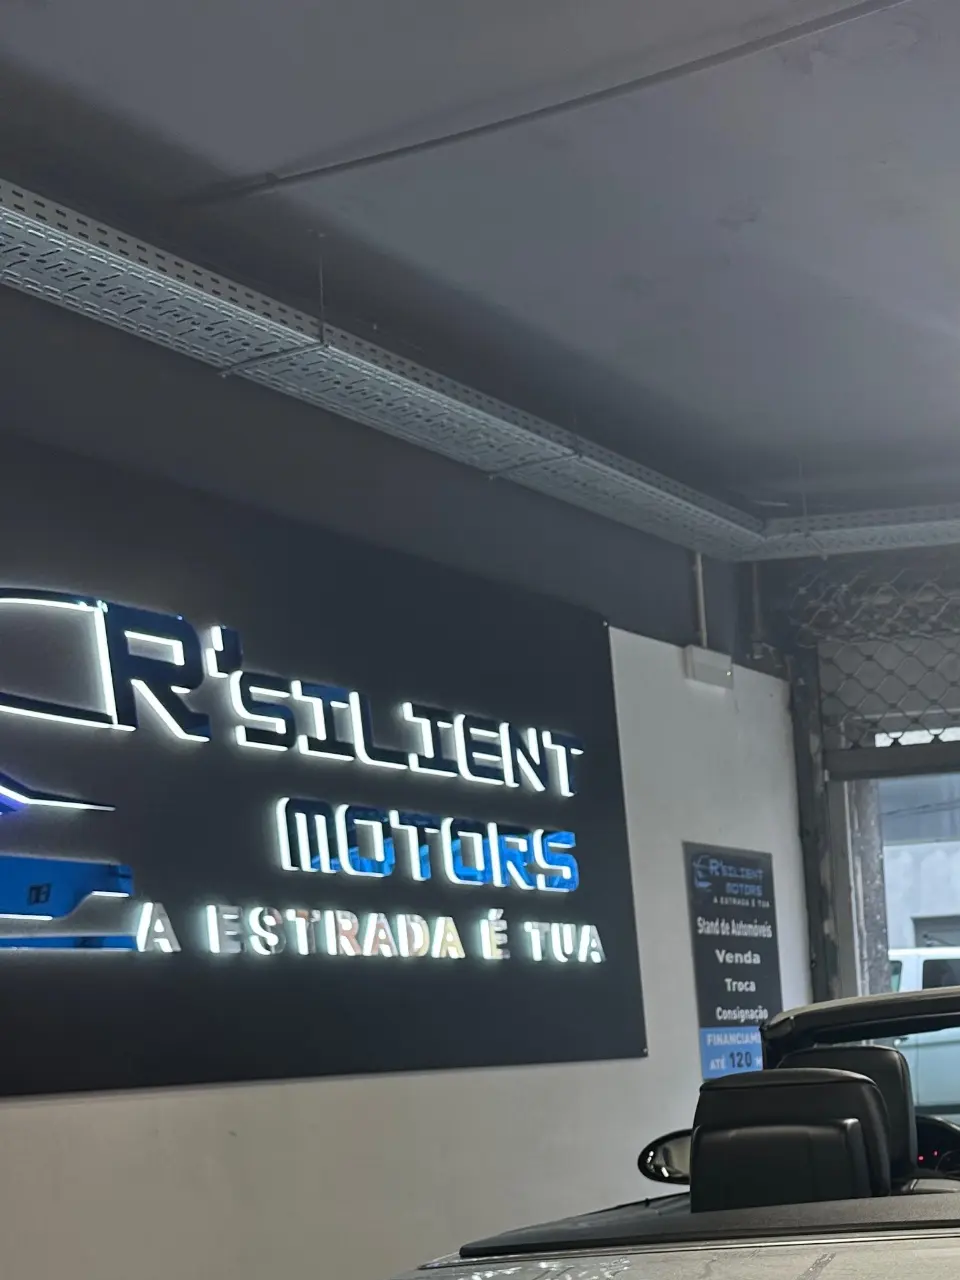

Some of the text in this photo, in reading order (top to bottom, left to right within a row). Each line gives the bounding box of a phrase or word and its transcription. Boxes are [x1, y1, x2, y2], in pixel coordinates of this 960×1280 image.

[275, 796, 580, 893] MOTORS
[136, 901, 607, 964] A ESTRADA É TUA
[697, 916, 773, 938] Stand de Automóveis
[715, 949, 761, 964] Venda
[724, 977, 756, 992] Troca
[716, 1005, 769, 1023] Consignação
[709, 1056, 726, 1071] ATÉ
[729, 1051, 753, 1069] 120
